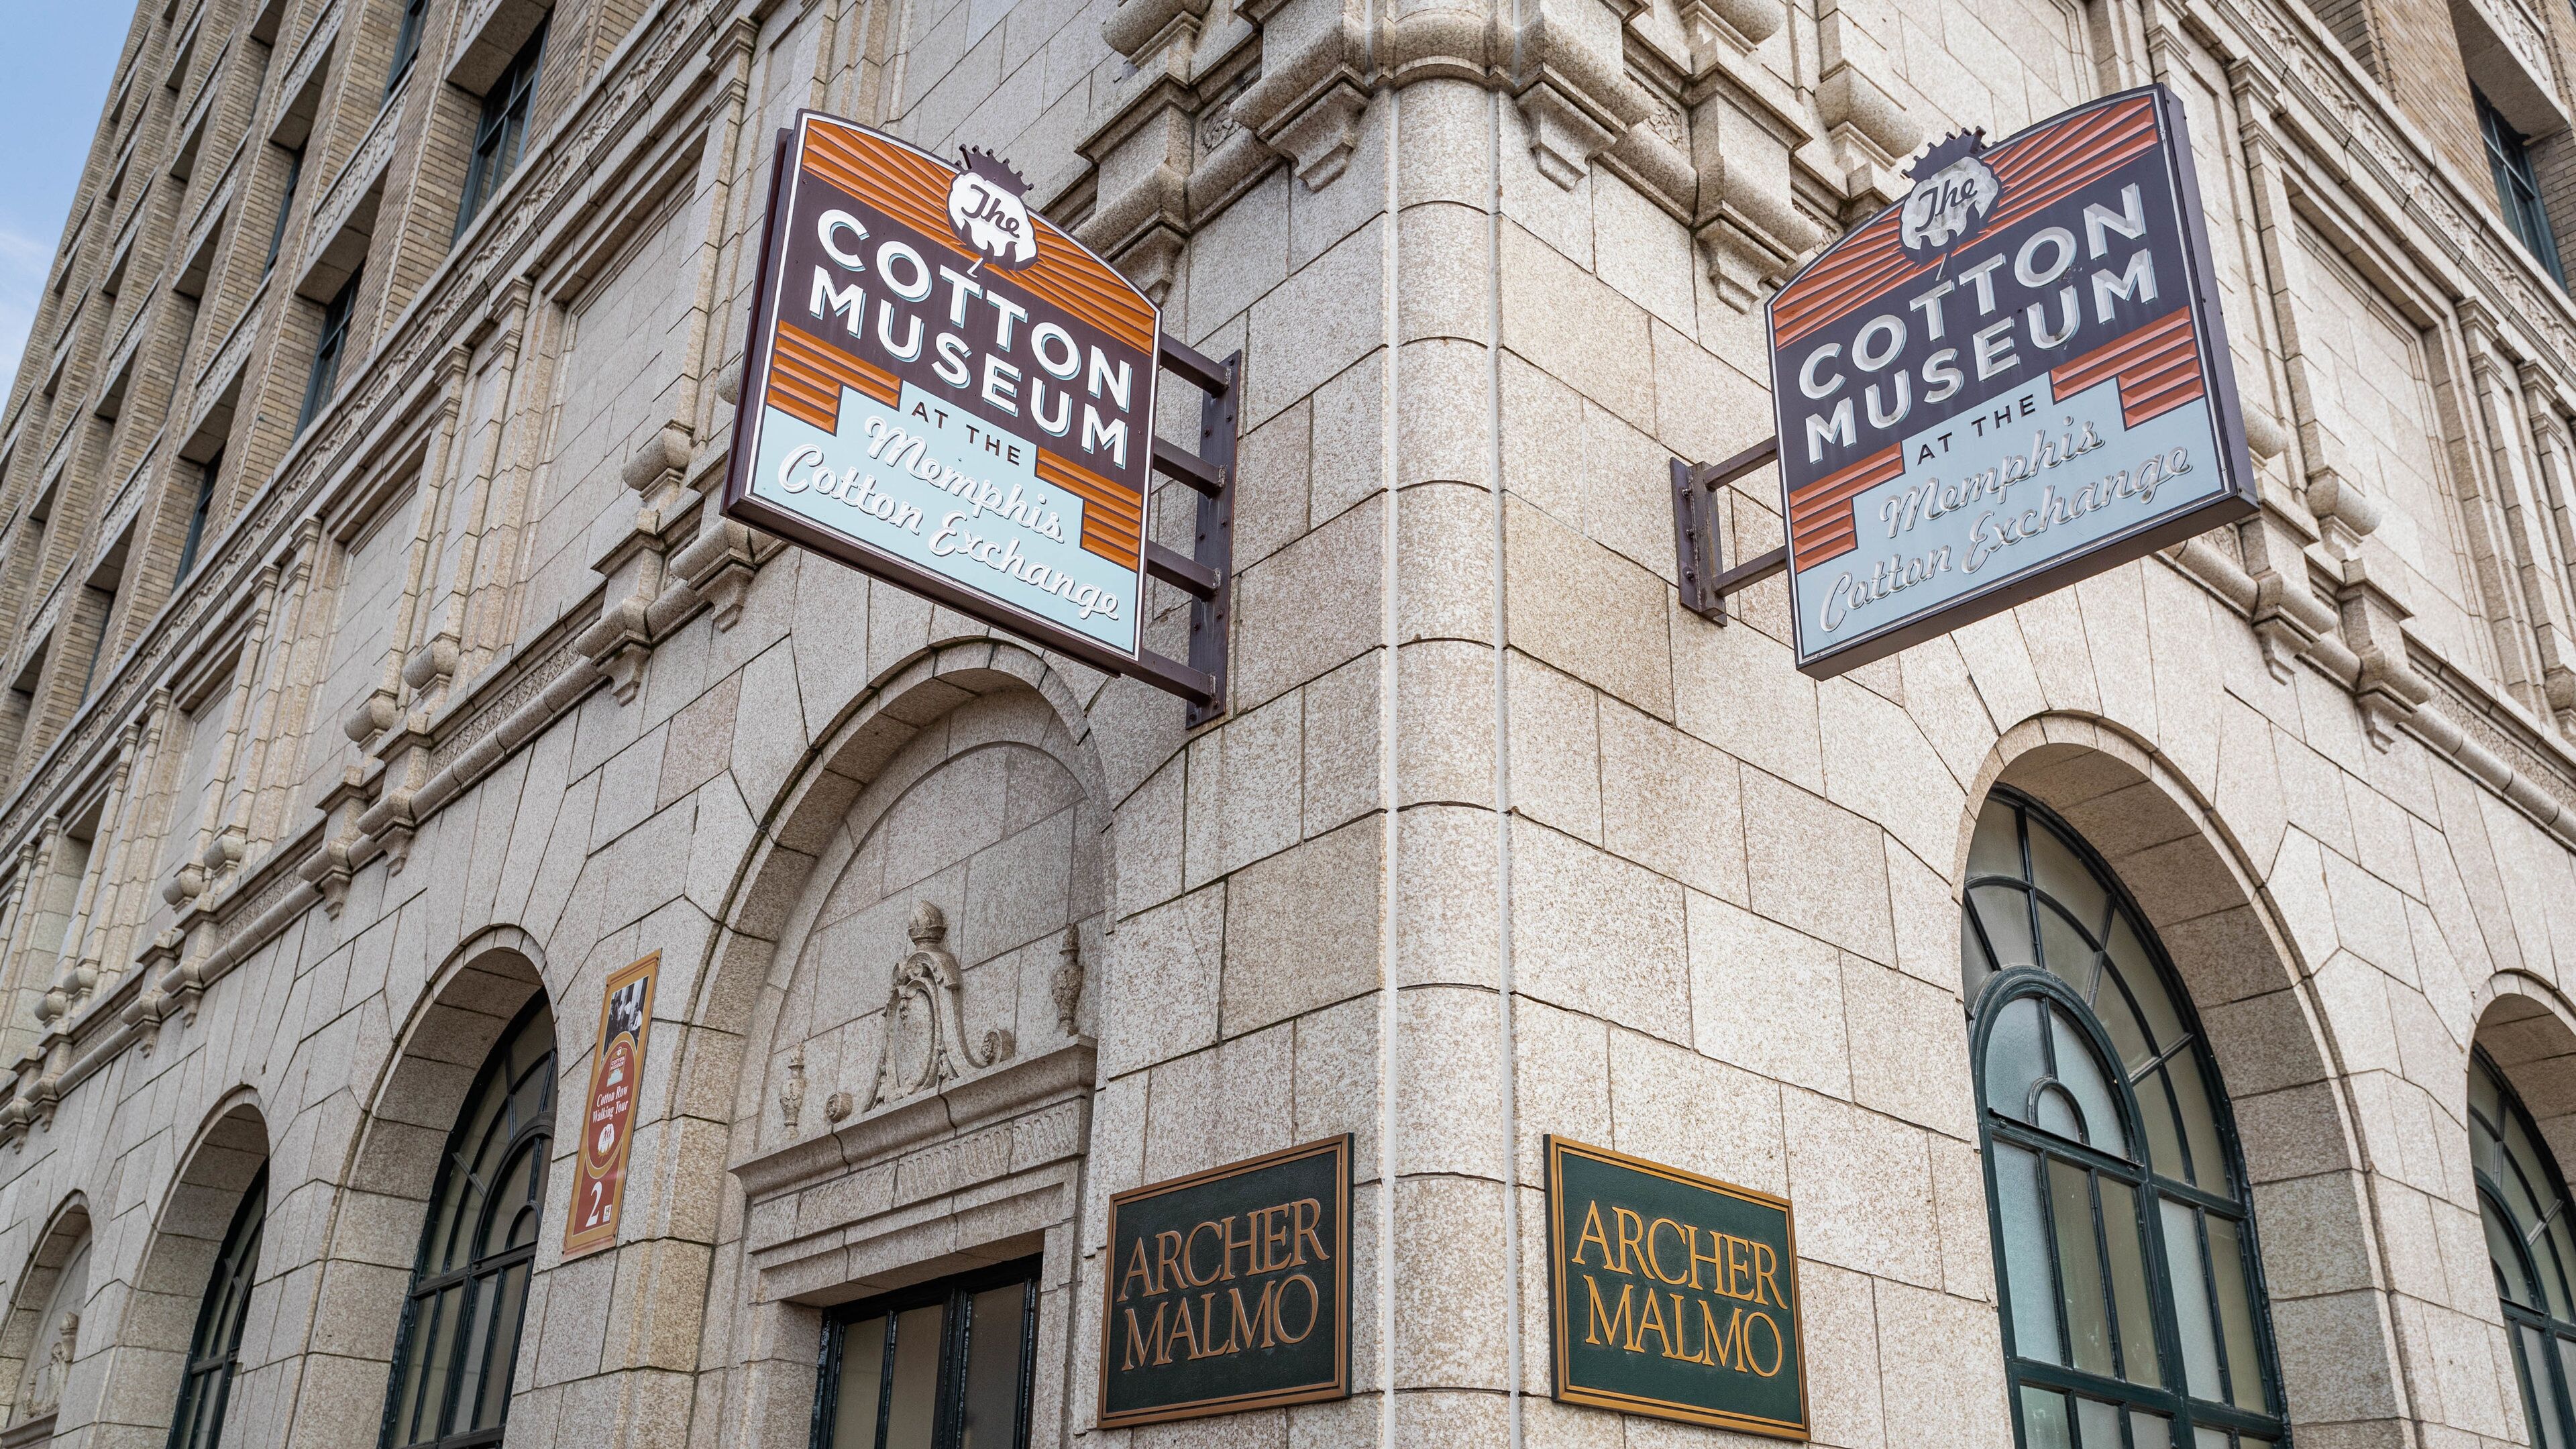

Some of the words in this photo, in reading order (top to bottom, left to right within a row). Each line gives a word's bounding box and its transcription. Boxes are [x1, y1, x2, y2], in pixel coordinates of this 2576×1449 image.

[963, 182, 1020, 238] The
[1915, 176, 1979, 232] The
[816, 208, 1132, 413] COTTON
[1799, 182, 2146, 401] COTTON
[808, 264, 1129, 469] MUSEUM
[1806, 249, 2158, 464] MUSEUM
[863, 415, 1065, 544] Memphis
[912, 401, 949, 431] AT
[966, 423, 1021, 466] THE
[1878, 415, 2106, 539] Memphis
[1917, 431, 1953, 466] AT
[1971, 393, 2038, 438] THE
[777, 443, 925, 537] Cotton
[928, 509, 1120, 622] Exchange
[1819, 544, 1952, 633] Cotton
[1961, 444, 2193, 576] Exchange
[592, 1105, 614, 1124] Walking
[615, 1101, 629, 1114] Tour
[596, 1091, 615, 1108] Cotton
[615, 1085, 629, 1099] Row
[611, 1056, 625, 1066] COTTON
[585, 1181, 602, 1228] 2
[1116, 1197, 1330, 1303] ARCHER
[1572, 1199, 1789, 1311] ARCHER
[1121, 1273, 1319, 1372] MALMO
[1583, 1273, 1784, 1378] MALMO
